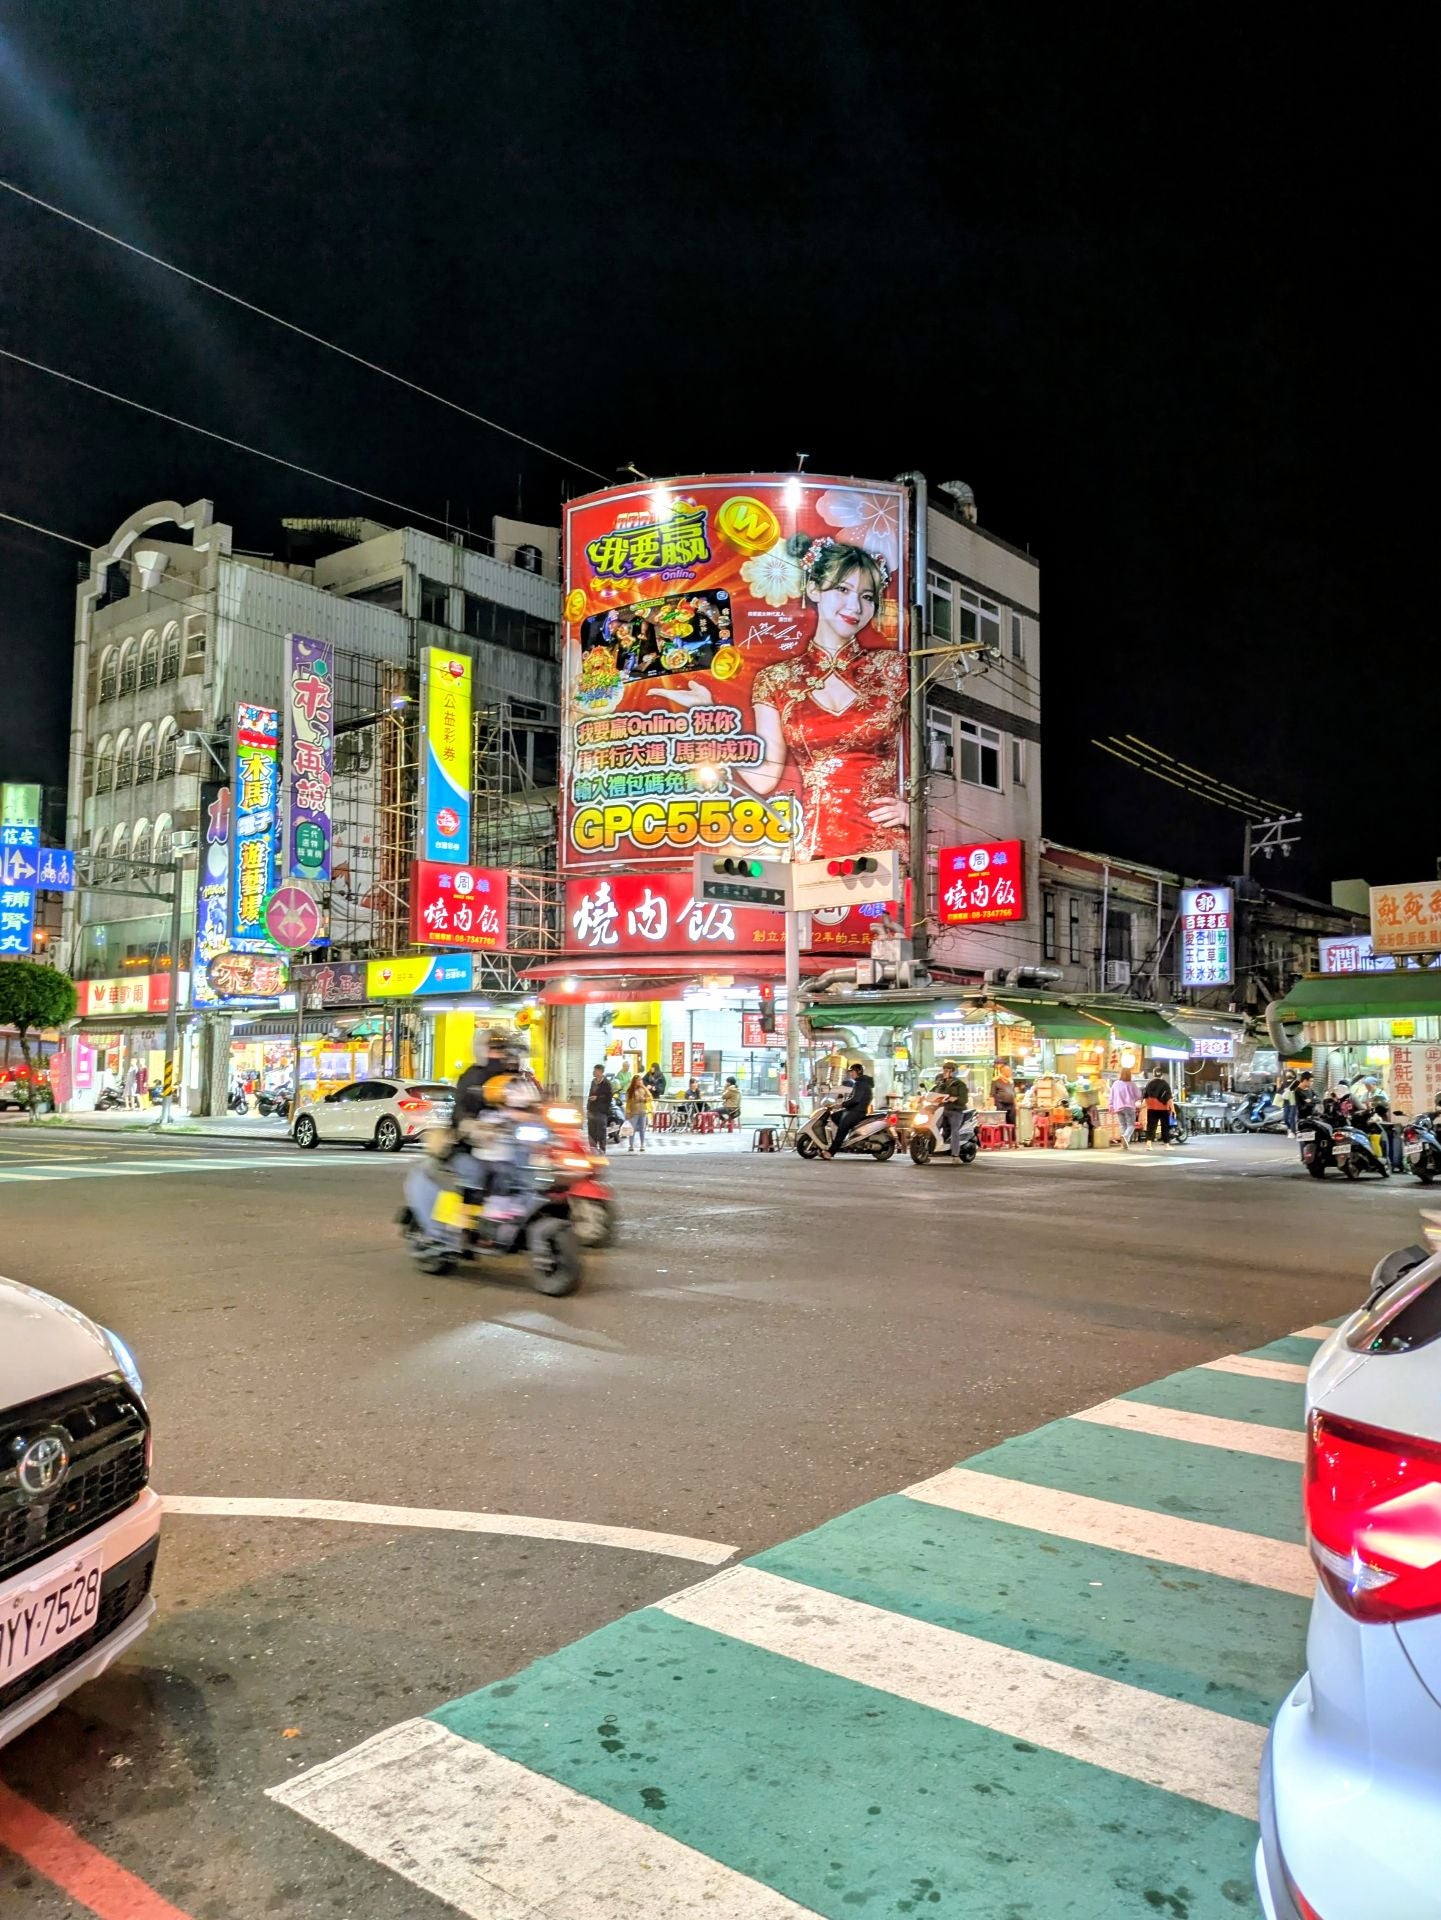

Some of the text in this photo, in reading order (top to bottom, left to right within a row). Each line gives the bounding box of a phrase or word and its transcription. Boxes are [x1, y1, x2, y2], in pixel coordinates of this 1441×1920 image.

[587, 515, 709, 574] 我要贏
[662, 570, 696, 580] Online
[443, 693, 456, 762] 公益彩券
[692, 709, 736, 734] 祝你
[674, 738, 759, 764] 馬到成功
[240, 752, 275, 806] 木馬
[3, 828, 35, 845] 信安
[573, 799, 798, 849] GPC5588
[944, 877, 1015, 911] 燒肉飯
[1196, 893, 1215, 911] 郭
[0, 890, 31, 951] 補腎丸
[424, 897, 499, 933] 燒肉飯
[573, 882, 736, 947] 燒肉飯
[971, 908, 1013, 918] 08-7347766
[1186, 914, 1228, 928] 百年老店
[1196, 930, 1205, 981] 杏仁冰
